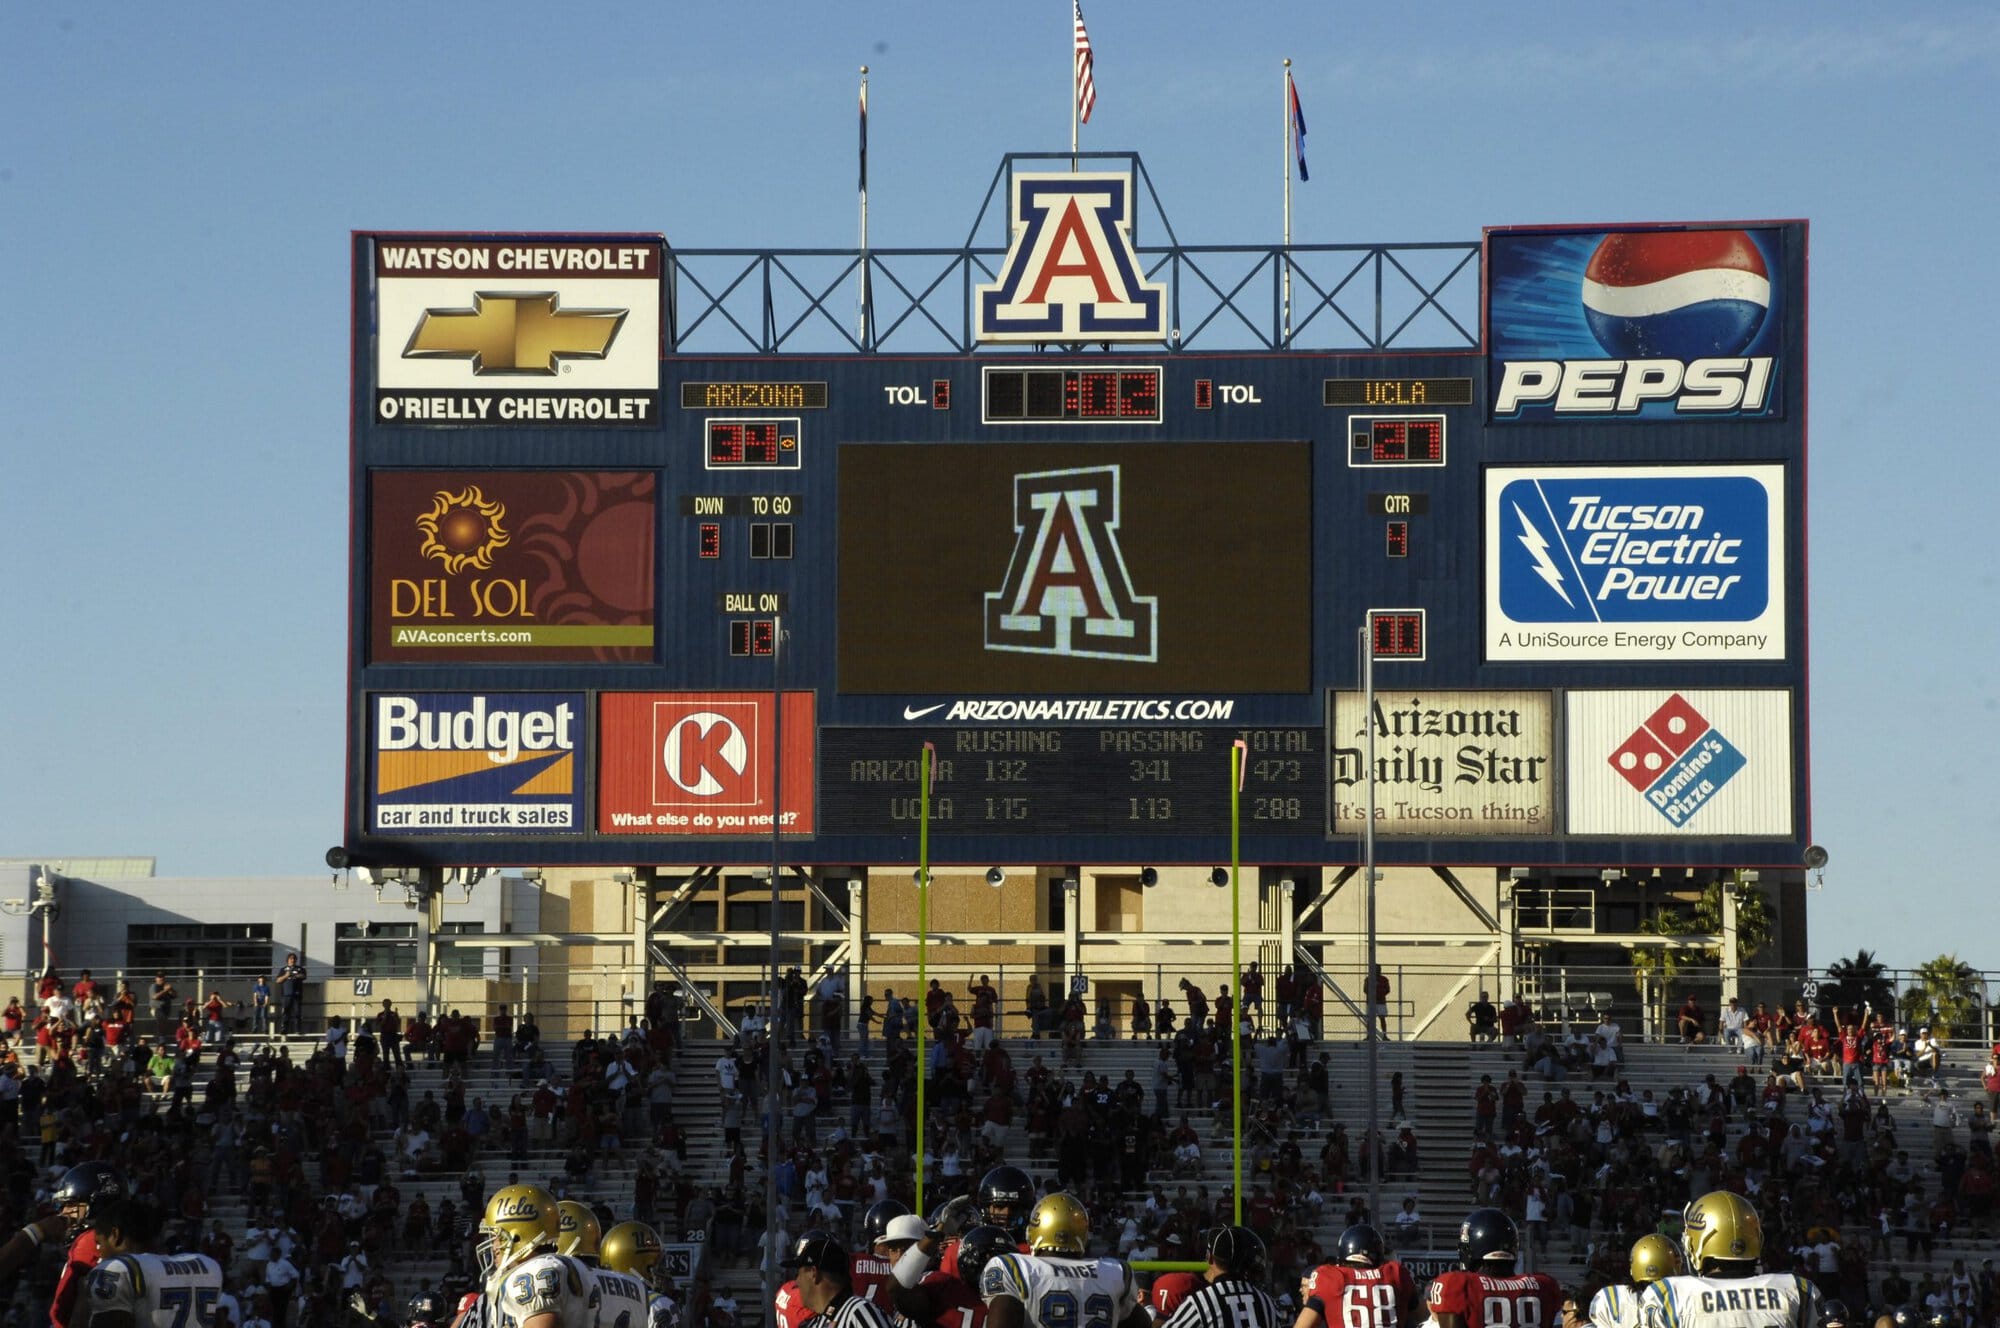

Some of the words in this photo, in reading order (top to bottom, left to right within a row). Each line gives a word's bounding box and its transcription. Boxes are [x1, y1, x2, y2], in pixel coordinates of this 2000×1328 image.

[382, 248, 492, 270] WATSON
[497, 248, 650, 271] CHEVROLET
[975, 172, 1167, 340] A
[706, 384, 804, 406] ARIZONA
[884, 386, 928, 405] TOL
[1218, 385, 1261, 404] TOL
[1366, 382, 1425, 404] UCLA
[1495, 357, 1773, 413] PEPSI
[380, 397, 492, 419] O'RIELLY
[498, 397, 650, 419] CHEVROLET
[712, 425, 776, 462] 34
[1374, 421, 1440, 460] 27
[695, 497, 723, 515] DWN
[752, 497, 768, 515] TO
[773, 497, 791, 515] GO
[1385, 495, 1410, 513] QTR
[1567, 496, 1704, 530] Tucson
[701, 525, 718, 556] 3
[1389, 524, 1406, 555] 4
[1581, 532, 1742, 564] Electric
[1597, 567, 1741, 600] Power
[391, 579, 455, 617] DEL
[470, 579, 535, 617] SOL
[726, 594, 755, 612] BALL
[760, 594, 778, 612] ON
[397, 629, 531, 643] AVAconcerts.com
[1499, 632, 1512, 647] A
[1518, 632, 1608, 648] UniSource
[1615, 632, 1677, 651] Energy
[1682, 632, 1768, 651] Company
[945, 700, 1234, 720] ARIZONAATHLETICS.COM
[1356, 698, 1521, 738] Arizona
[378, 696, 573, 763] Budget
[956, 730, 1061, 752] RUSHING
[1101, 730, 1203, 751] PASSING
[1238, 730, 1314, 751] TOTAL
[850, 760, 953, 781] ARIZOA
[986, 760, 1028, 781] 132
[1130, 760, 1171, 781] 341
[1254, 760, 1301, 781] 473
[1332, 745, 1443, 793] Daily
[1455, 745, 1547, 785] Star
[1649, 739, 1723, 808] Domino's
[1254, 798, 1301, 819] 288
[1665, 779, 1714, 822] Pizza
[381, 808, 413, 825] car
[419, 805, 454, 825] and
[461, 804, 511, 825] truck
[518, 804, 568, 825] sales
[611, 813, 652, 826] What
[657, 813, 688, 826] else
[693, 813, 713, 826] do
[717, 815, 745, 828] you
[1335, 802, 1366, 820] It's
[1374, 808, 1386, 820] a
[1395, 802, 1472, 820] Tucson
[1482, 802, 1546, 824] thing.
[356, 979, 370, 995] 27
[1072, 978, 1087, 992] 28
[1802, 982, 1818, 998] 29
[687, 1229, 704, 1241] 28
[1051, 1264, 1099, 1279] PRICE
[513, 1268, 560, 1306] 33
[1159, 1289, 1169, 1311] 7
[1342, 1284, 1398, 1328] 68
[1702, 1288, 1782, 1313] CARTER
